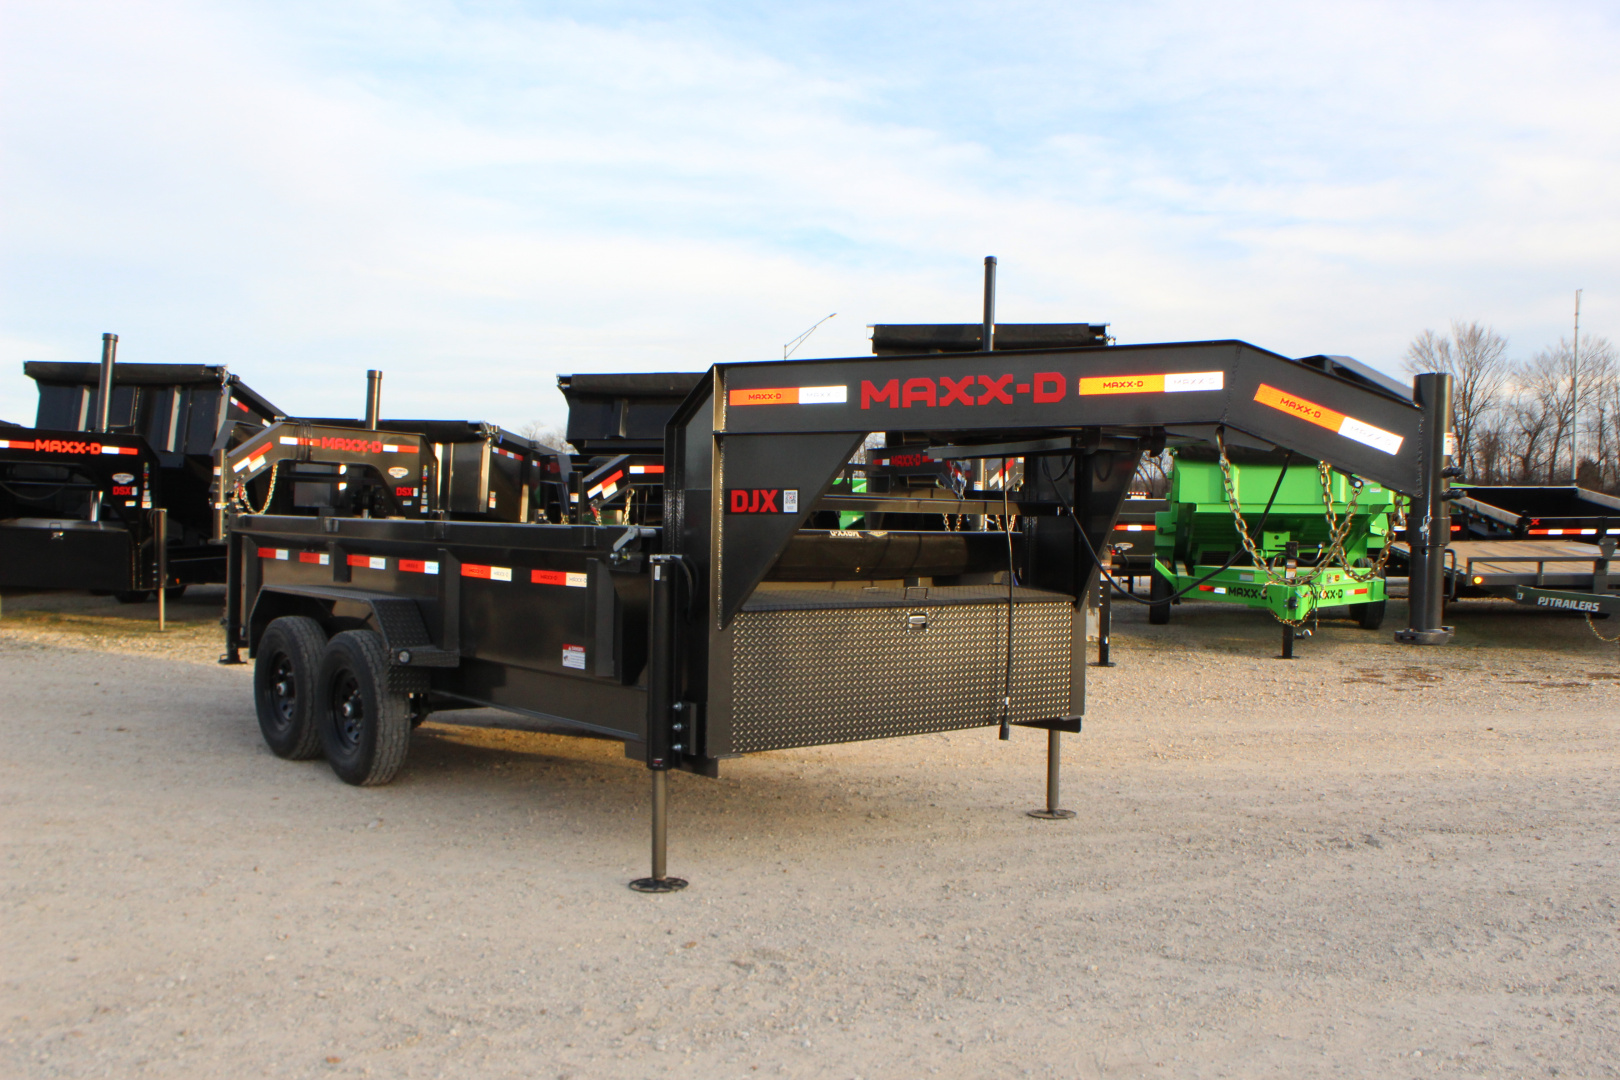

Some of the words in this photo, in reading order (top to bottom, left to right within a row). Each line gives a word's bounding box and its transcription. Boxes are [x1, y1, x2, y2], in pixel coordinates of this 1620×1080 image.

[860, 371, 1067, 410] MAXX-D
[1102, 380, 1144, 389] MAXX-D
[1280, 397, 1322, 419] MAXX-D
[35, 439, 101, 455] MAXX-D
[321, 436, 382, 453] MAXX-D
[890, 453, 921, 467] MAXX-D
[112, 486, 131, 496] DSX
[396, 486, 413, 497] DSX
[730, 489, 779, 513] DJX
[1538, 596, 1549, 606] PJ
[1549, 597, 1600, 612] TRAILERS
